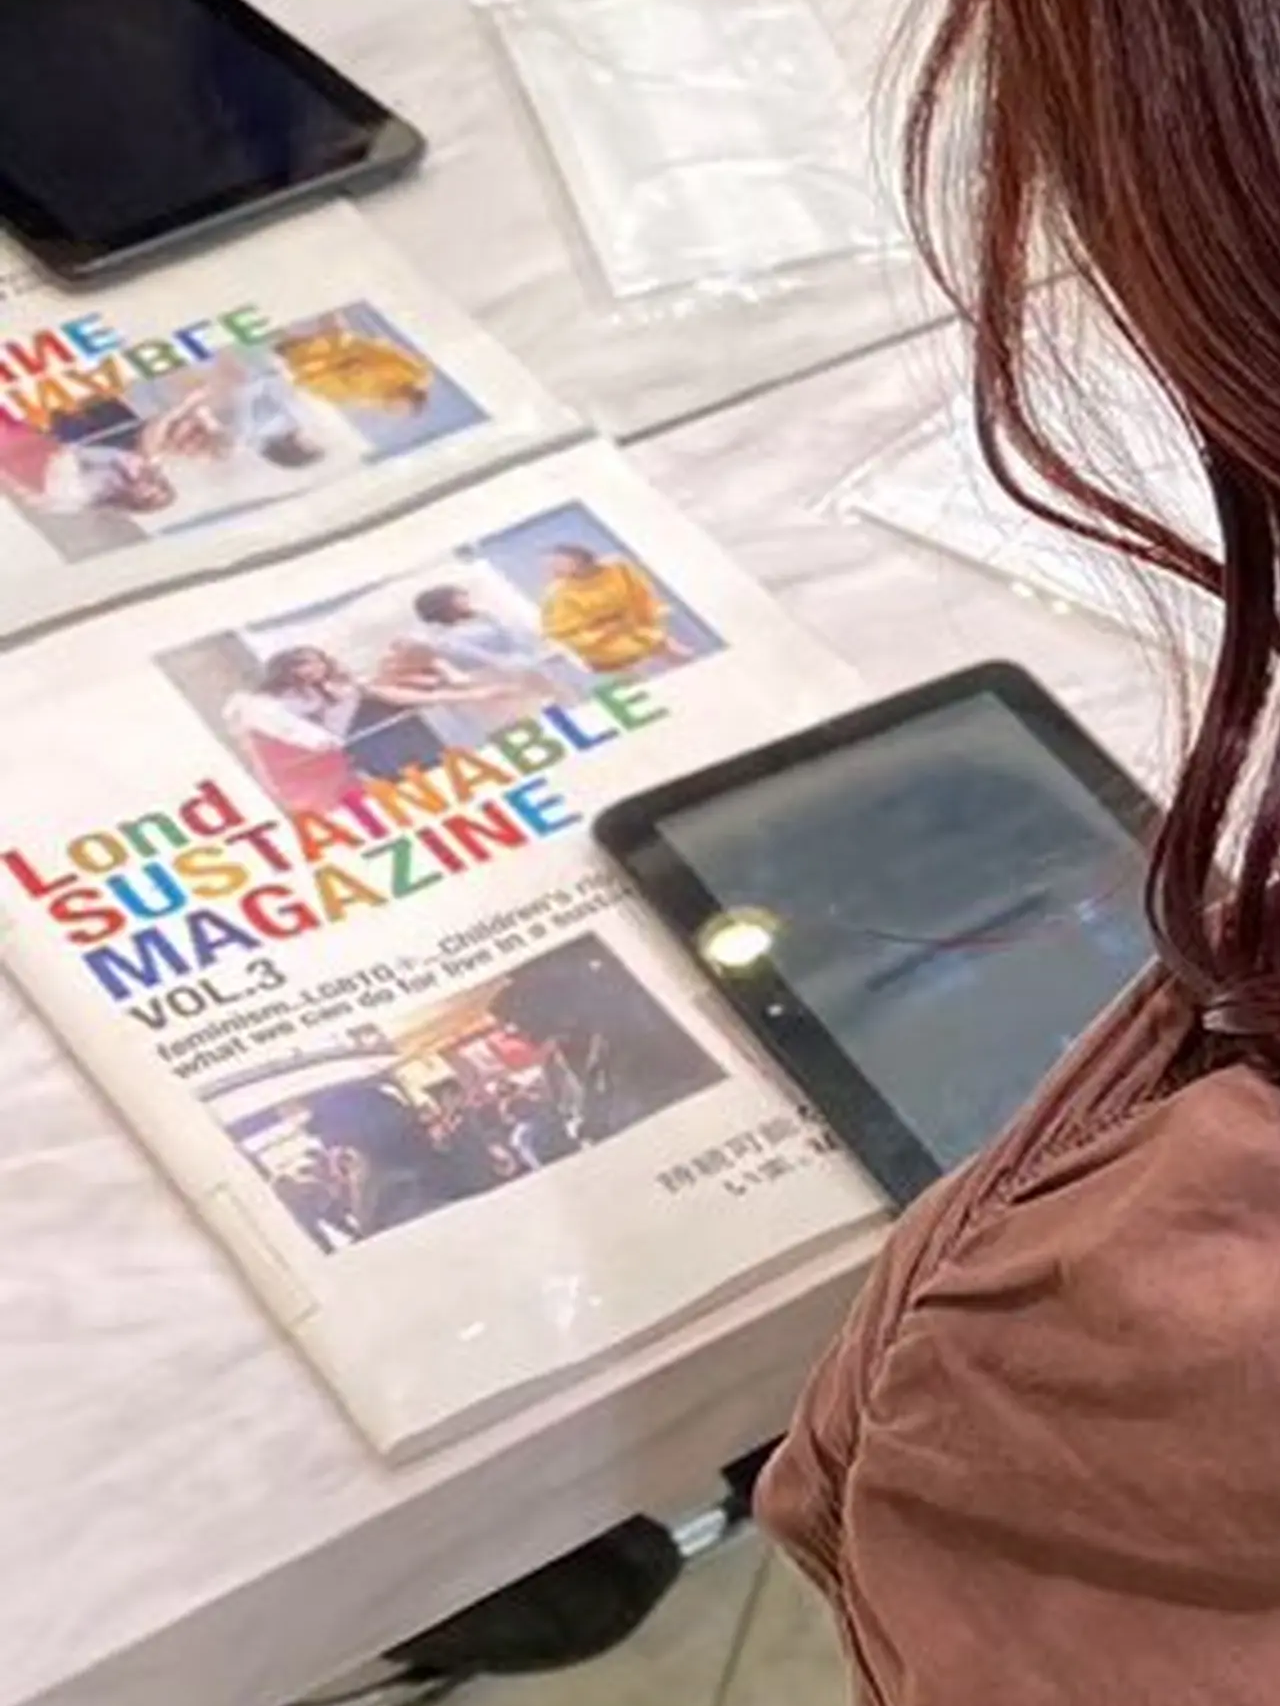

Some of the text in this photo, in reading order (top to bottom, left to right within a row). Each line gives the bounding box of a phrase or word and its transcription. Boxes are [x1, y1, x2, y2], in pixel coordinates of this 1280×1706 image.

[3, 780, 246, 899] Lond
[48, 678, 668, 945] SUSTAINABLE
[82, 779, 581, 1001] MAGAZINE
[130, 957, 287, 1031] VOL.3
